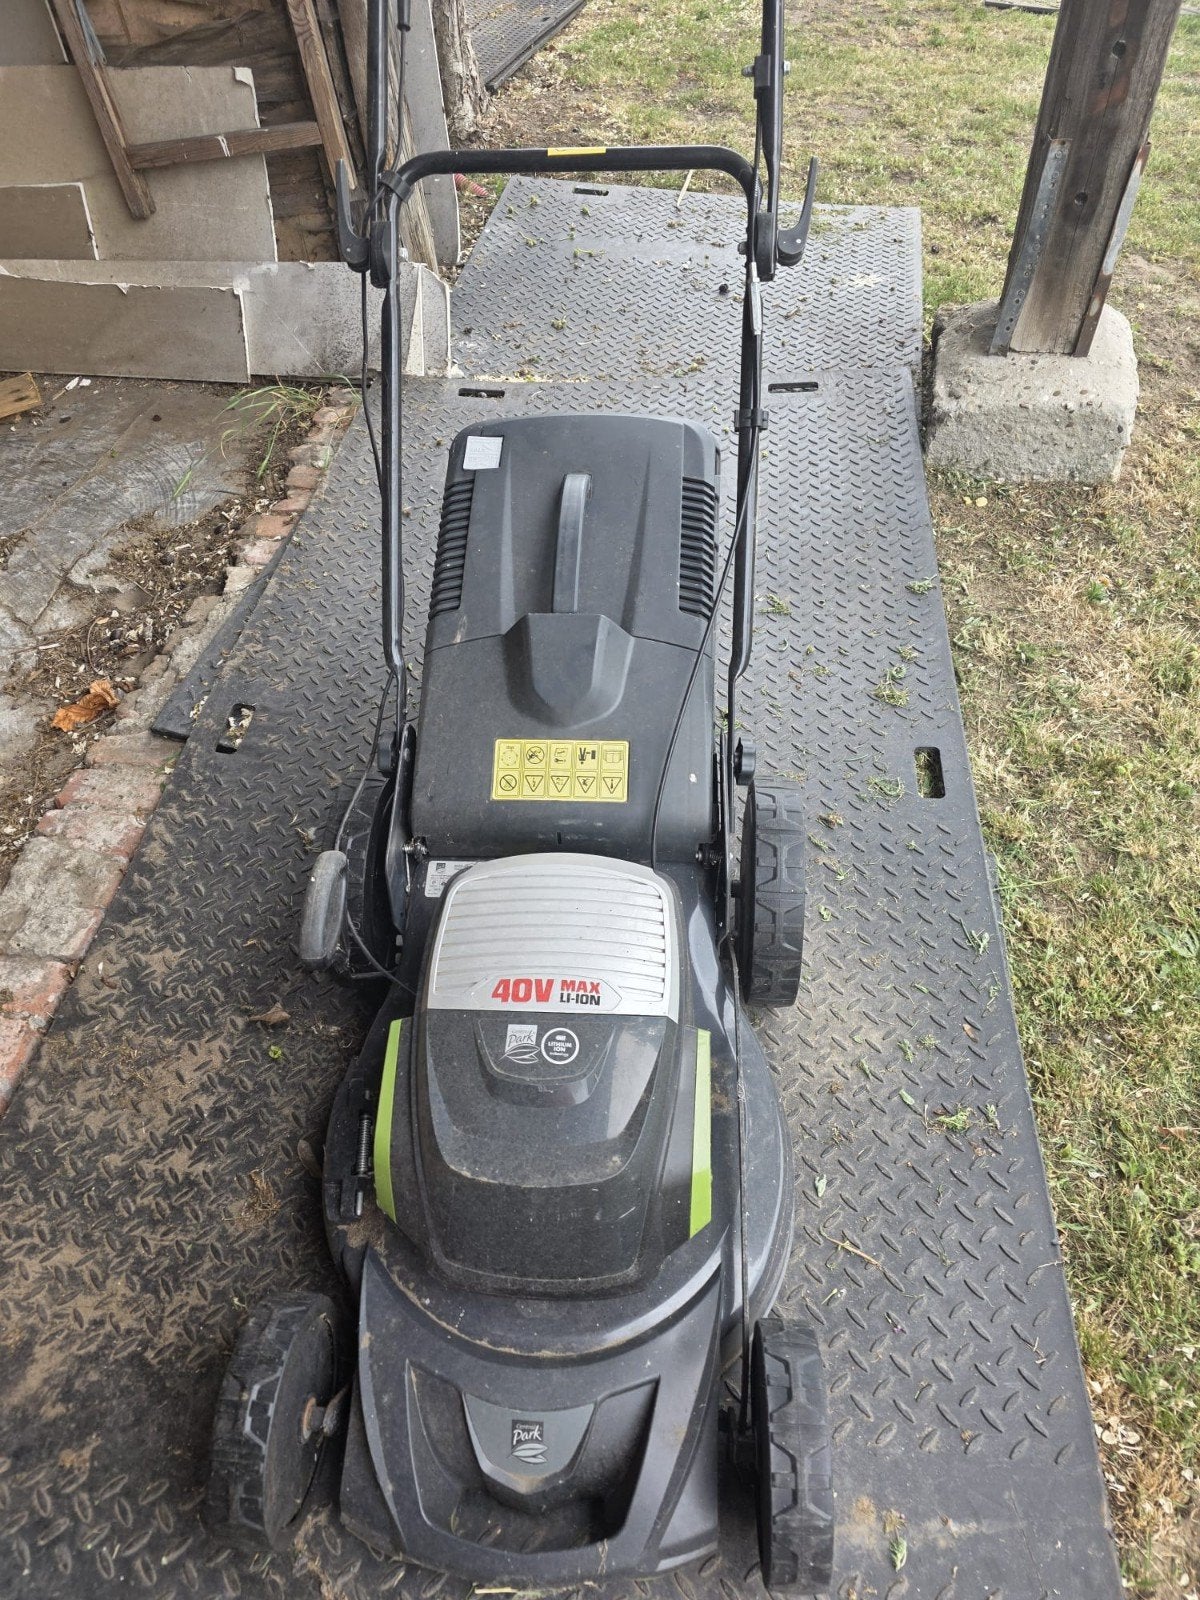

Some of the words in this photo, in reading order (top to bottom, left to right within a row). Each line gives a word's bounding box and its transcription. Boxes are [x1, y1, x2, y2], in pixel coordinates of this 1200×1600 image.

[491, 978, 555, 1003] 40V
[561, 980, 600, 994] MAX
[560, 992, 601, 1006] LI-ION
